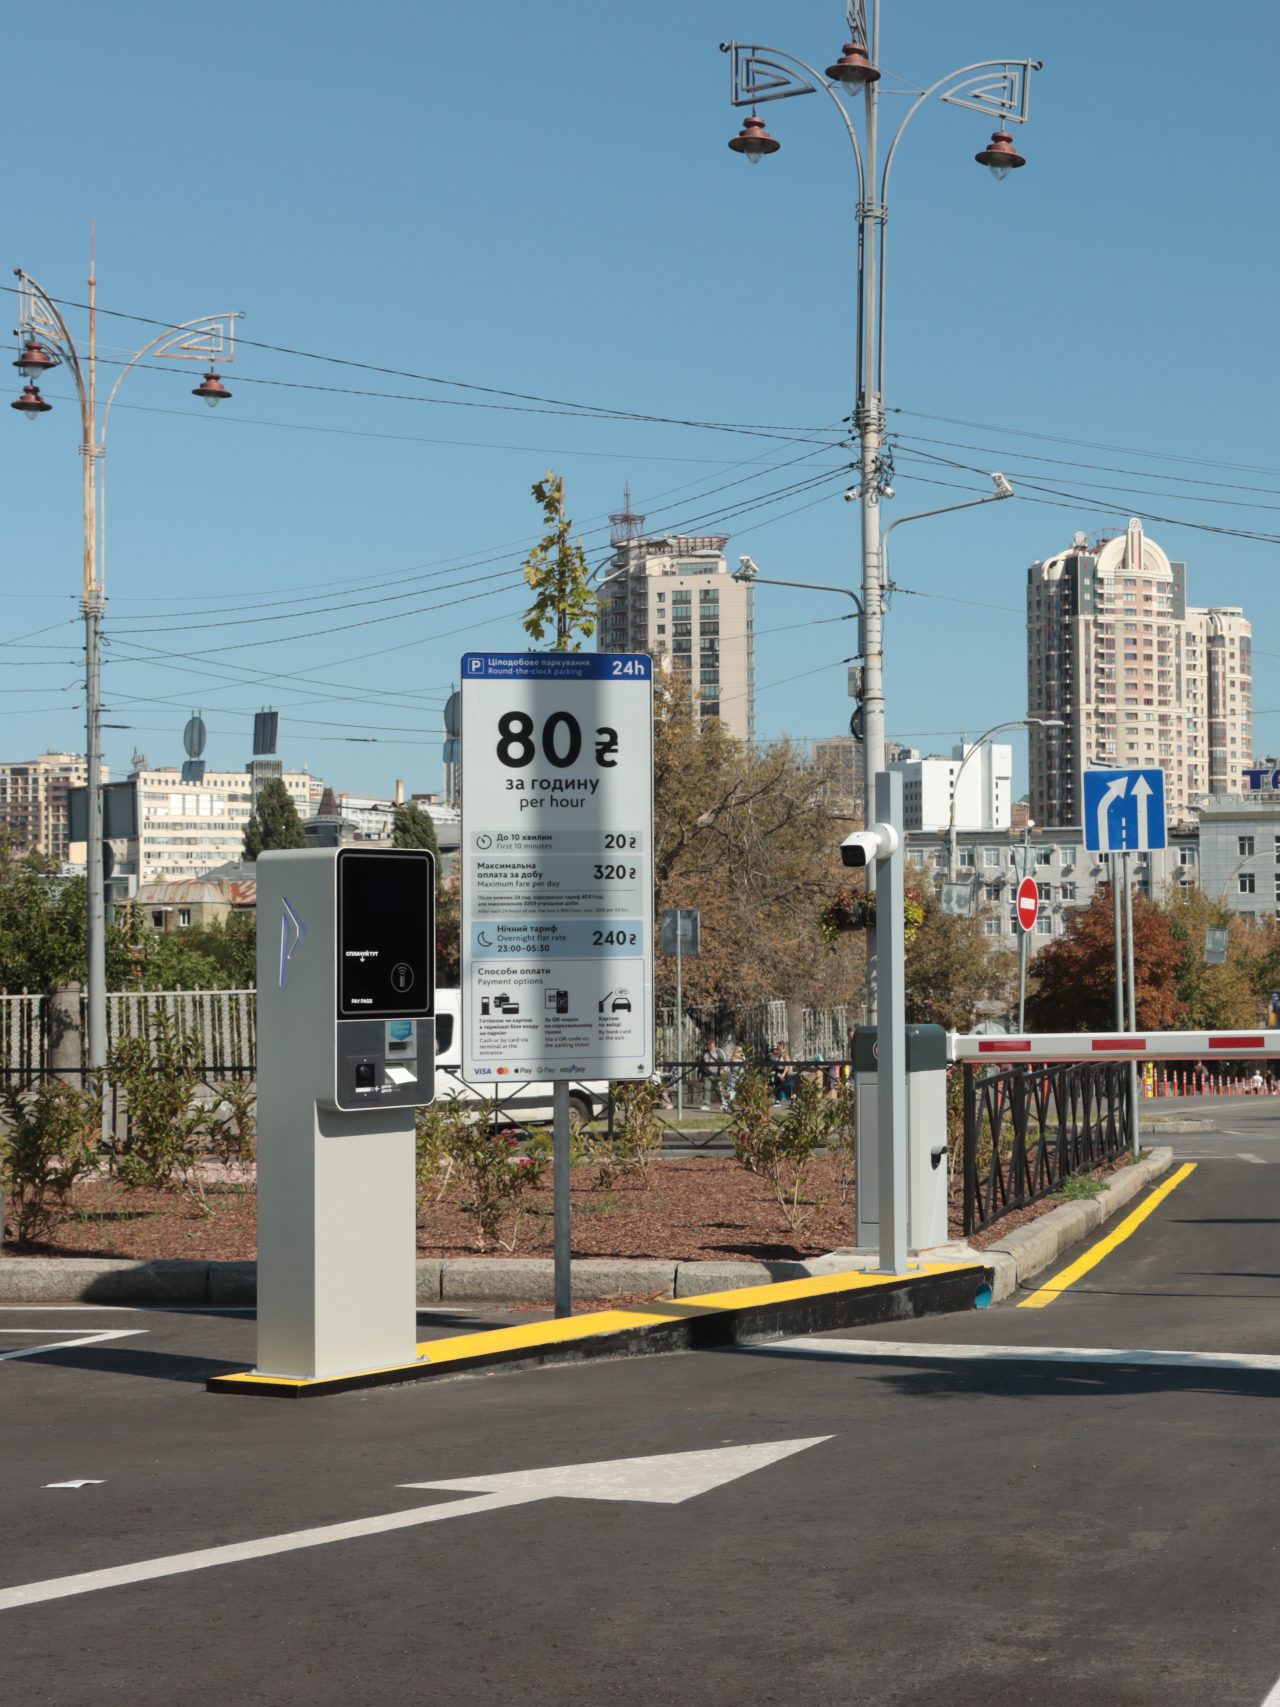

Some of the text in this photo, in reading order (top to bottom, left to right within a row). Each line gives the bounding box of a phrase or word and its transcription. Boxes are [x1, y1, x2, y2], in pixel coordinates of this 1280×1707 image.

[488, 658, 591, 668] Цілодобове паркування
[612, 660, 645, 676] 24h
[488, 667, 583, 677] Round-the-clock parking
[496, 710, 582, 769] 80
[505, 778, 600, 795] за годину
[520, 795, 586, 812] per hour
[497, 834, 509, 842] До
[604, 834, 626, 849] 20
[497, 842, 553, 850] First 10 minutes
[477, 862, 536, 870] Максимальна
[477, 871, 508, 879] оплата
[521, 870, 543, 881] добу
[593, 864, 626, 880] 320
[477, 880, 560, 889] Maximum fare per day
[497, 925, 558, 934] Нічний тариф
[497, 934, 535, 944] Overnight
[537, 934, 550, 942] flat
[592, 930, 627, 946] 240
[478, 967, 518, 975] Способи
[478, 978, 544, 987] Payment options
[520, 1067, 532, 1075] Pay
